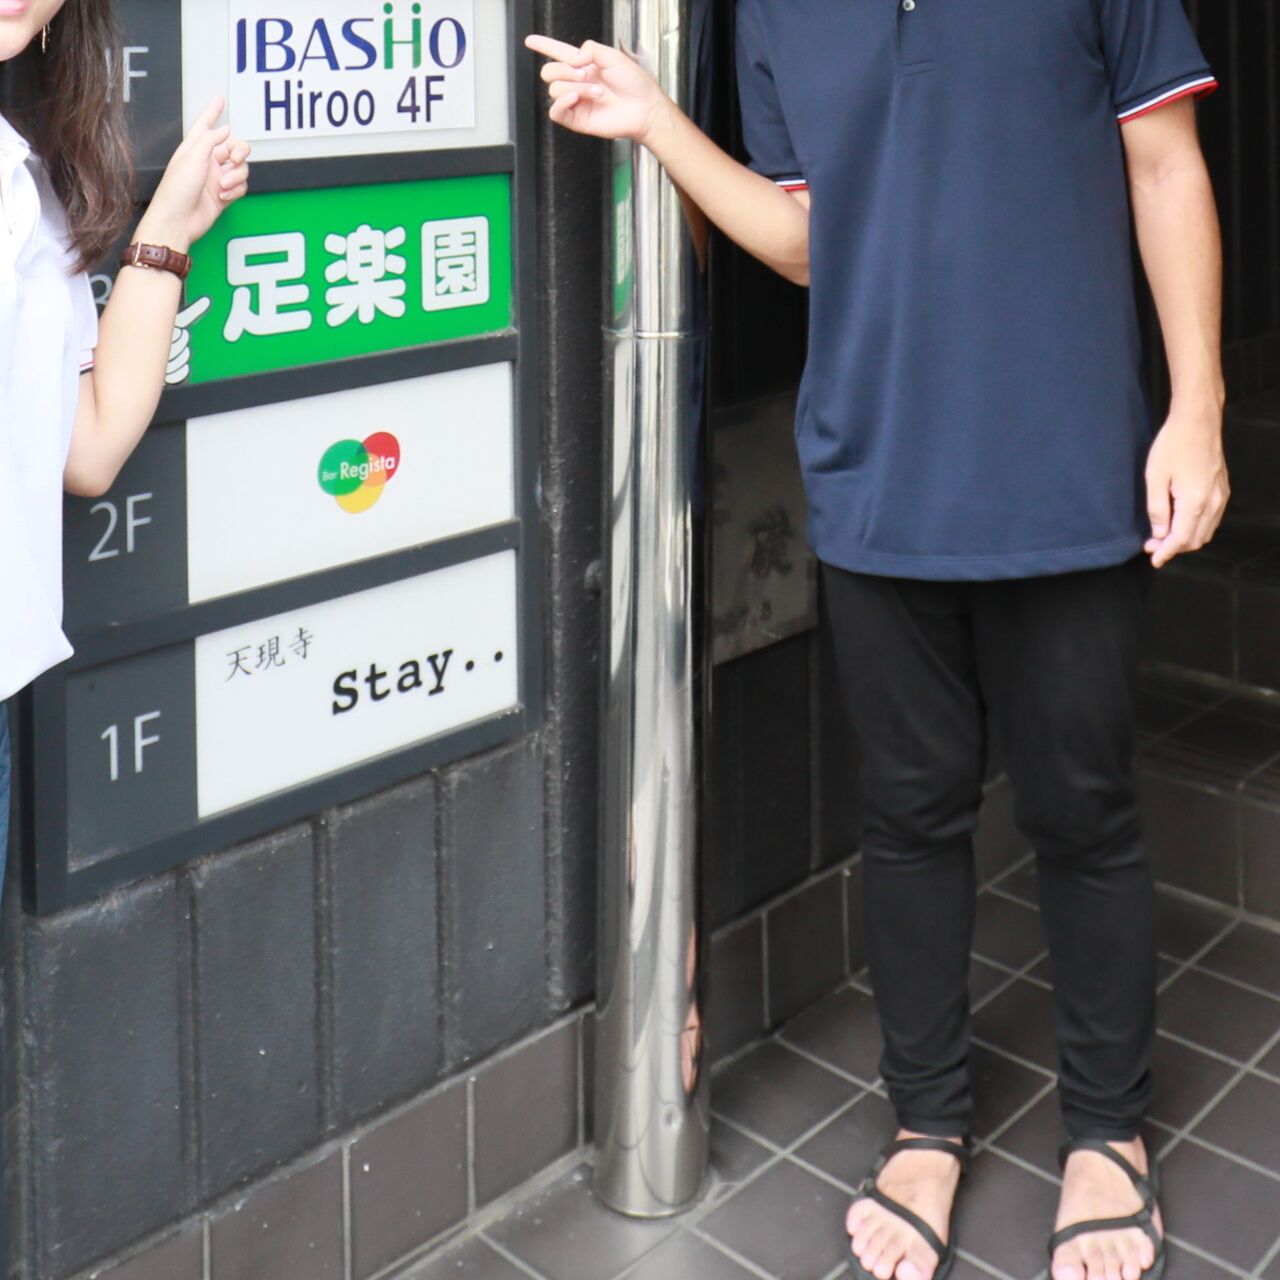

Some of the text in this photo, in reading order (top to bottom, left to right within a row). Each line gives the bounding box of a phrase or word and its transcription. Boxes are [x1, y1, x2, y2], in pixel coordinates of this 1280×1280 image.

[236, 2, 467, 74] IBASHO
[263, 74, 446, 131] Hiroo 4F
[222, 214, 491, 344] 足楽園
[340, 456, 396, 481] Regista
[87, 491, 154, 563] 2F
[224, 626, 315, 683] 天現寺
[100, 709, 162, 782] 1F
